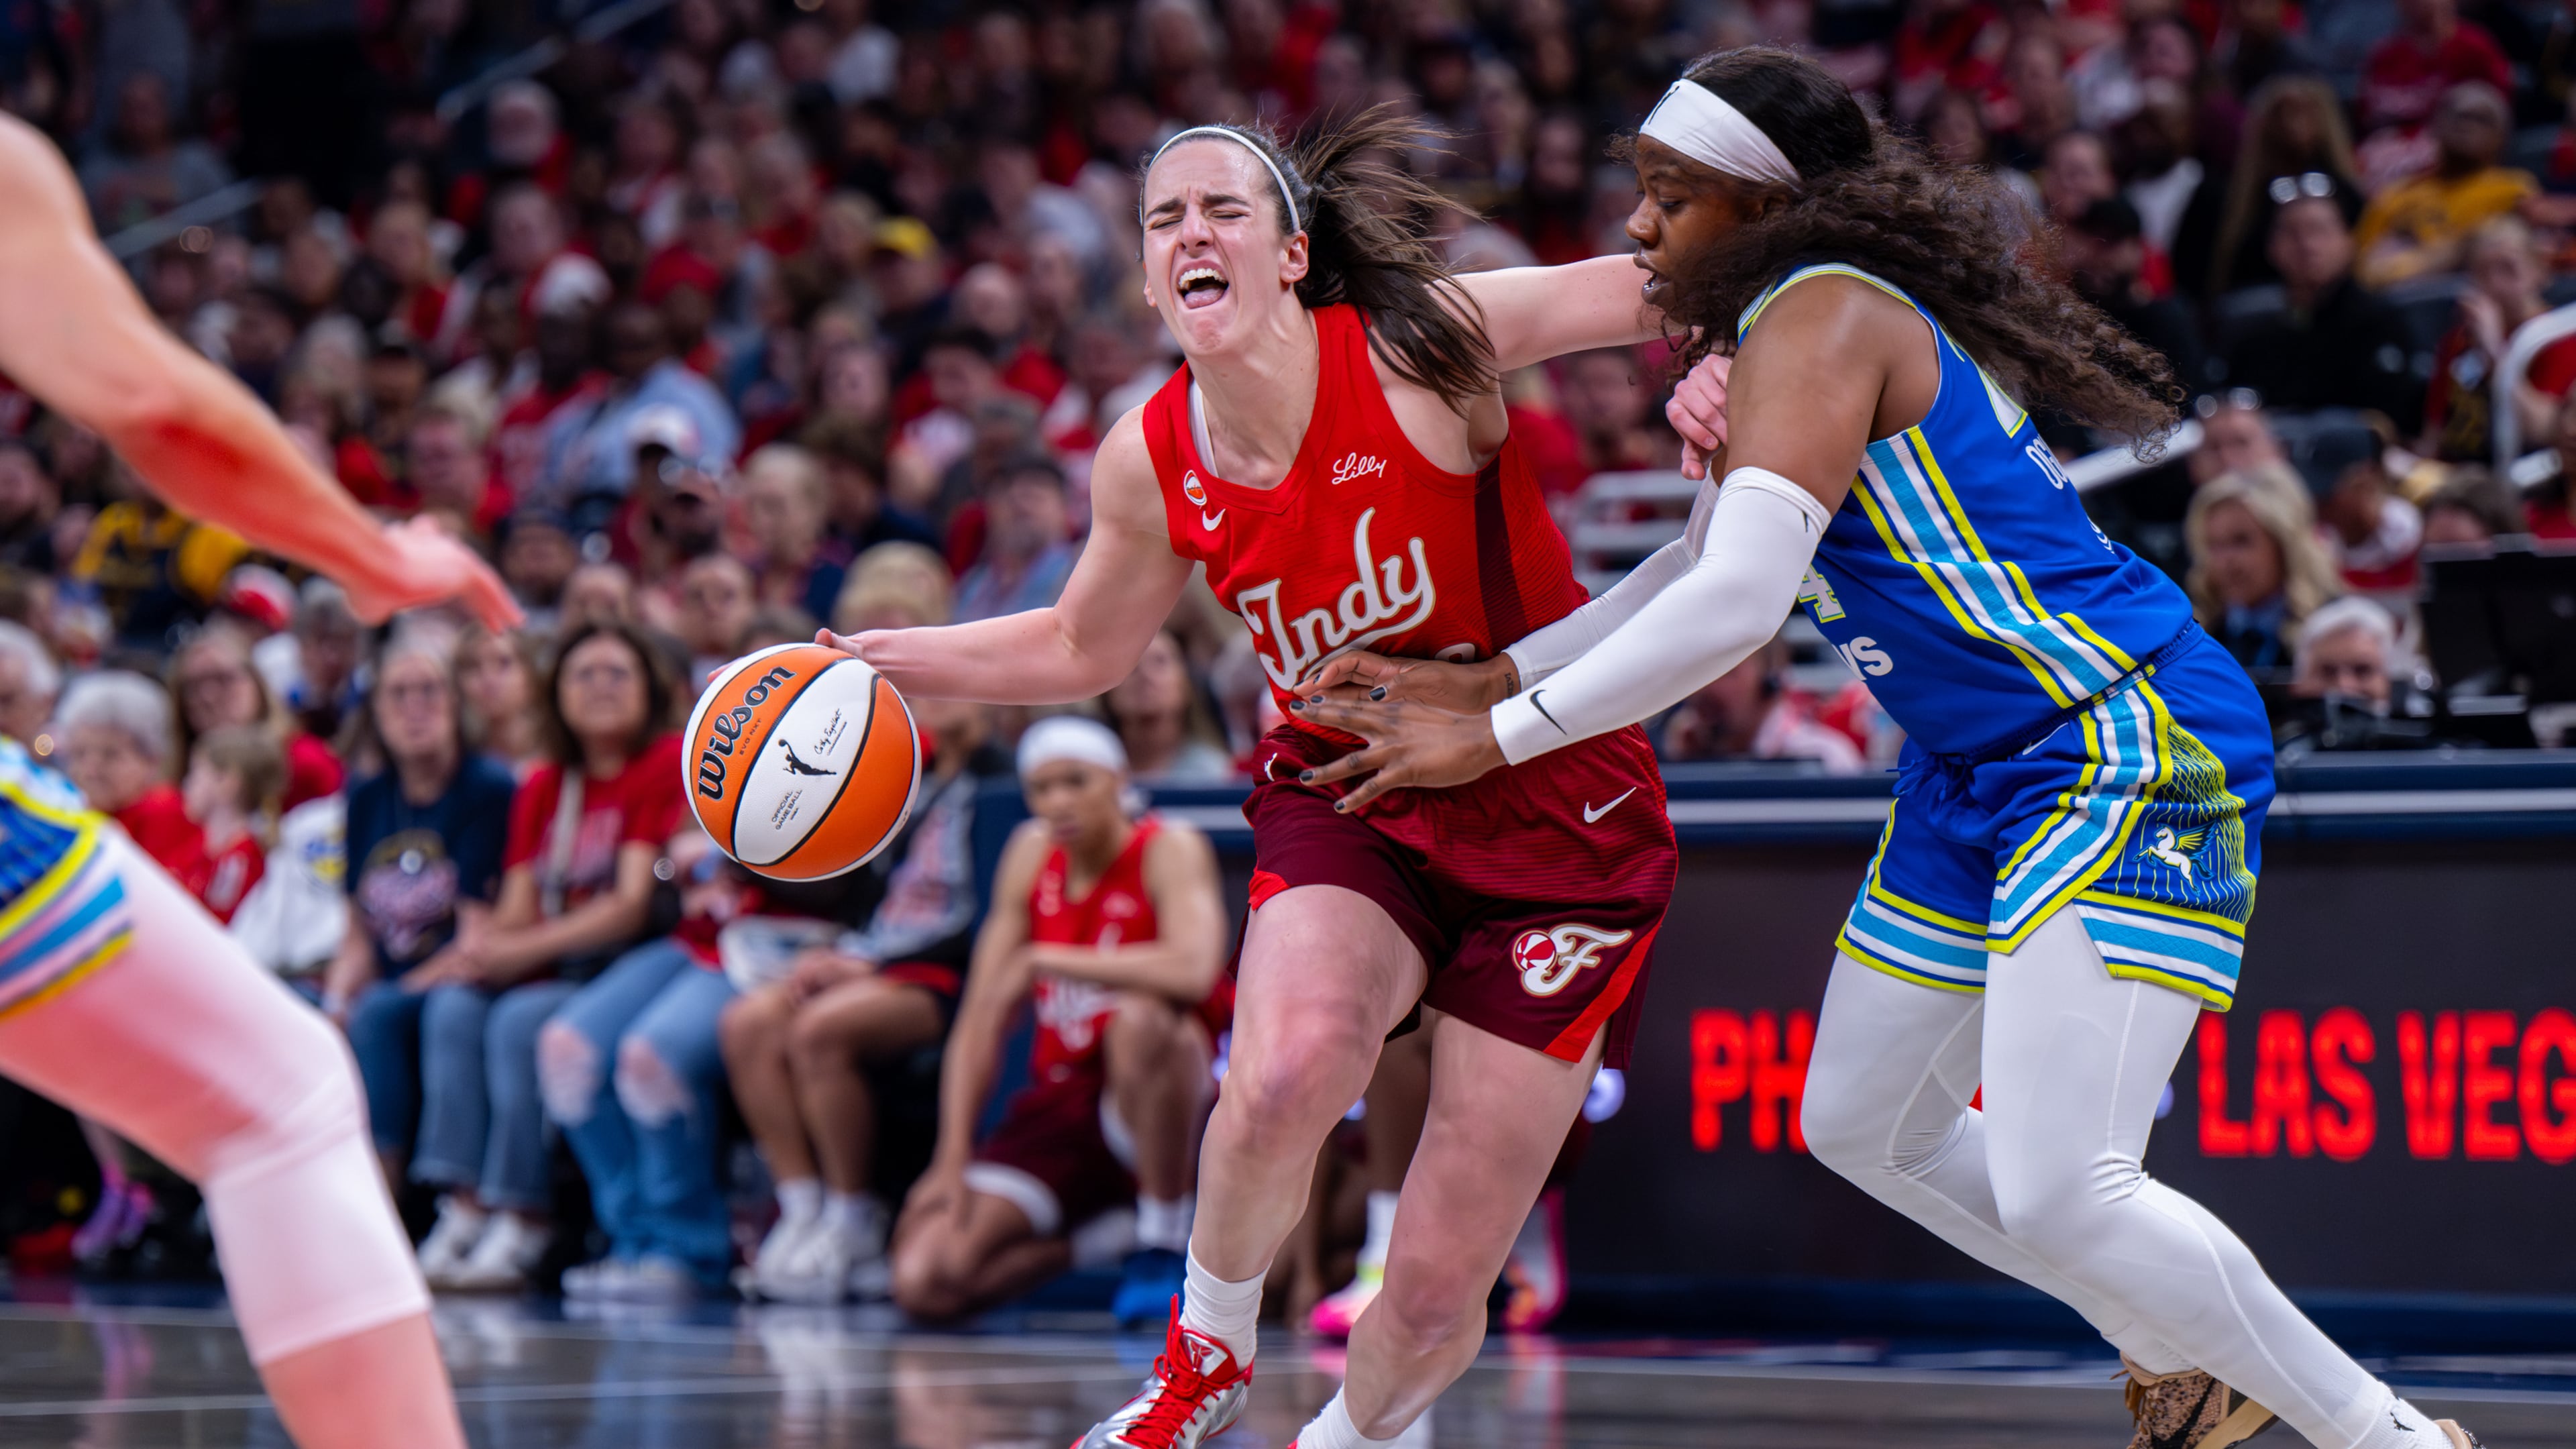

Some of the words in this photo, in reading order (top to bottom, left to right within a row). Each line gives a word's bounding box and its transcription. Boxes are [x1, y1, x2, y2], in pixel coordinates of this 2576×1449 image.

[1332, 451, 1387, 485] Lilly
[1236, 506, 1436, 691] Indy
[698, 666, 797, 801] Wilson
[739, 737, 750, 755] EVO
[749, 718, 761, 735] NXT
[771, 791, 793, 822] OFFICIAL
[775, 808, 791, 830] GAME
[788, 790, 802, 809] BALL
[2198, 1006, 2377, 1162] LAS
